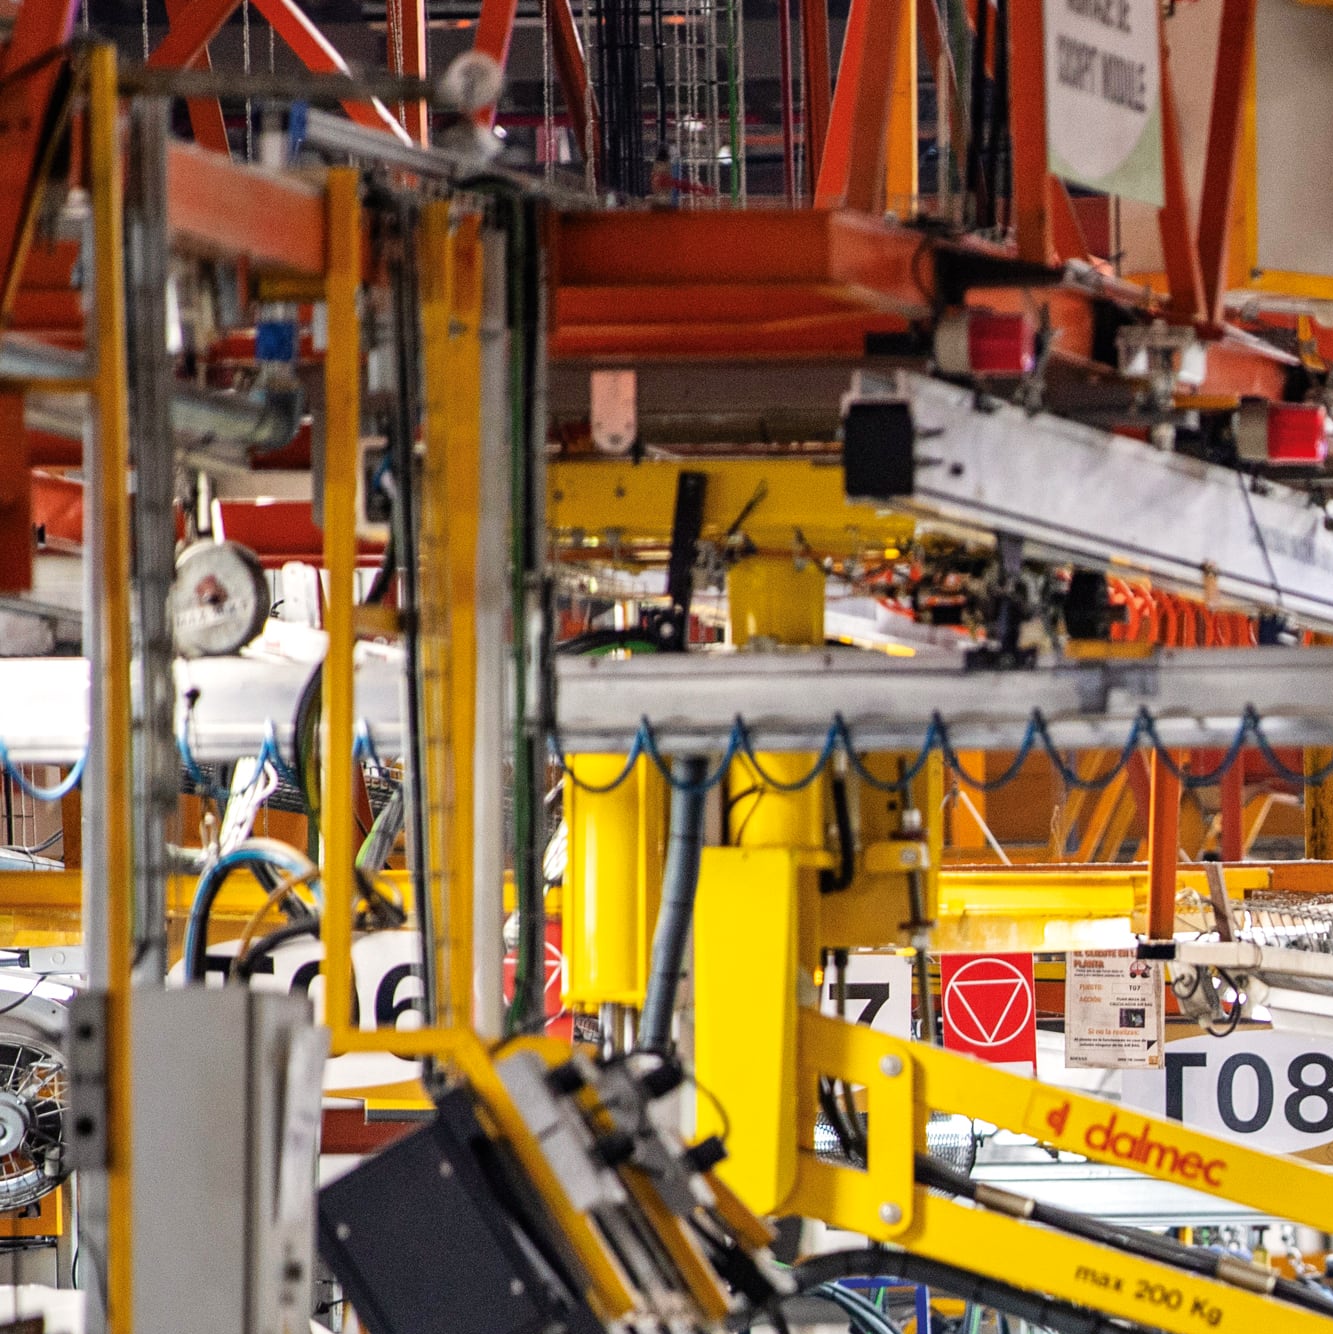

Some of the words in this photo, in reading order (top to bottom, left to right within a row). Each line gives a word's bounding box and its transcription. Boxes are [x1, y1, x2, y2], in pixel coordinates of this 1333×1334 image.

[1084, 1111, 1228, 1188] dalmec
[1074, 1265, 1122, 1293] max
[1134, 1278, 1183, 1312] 200
